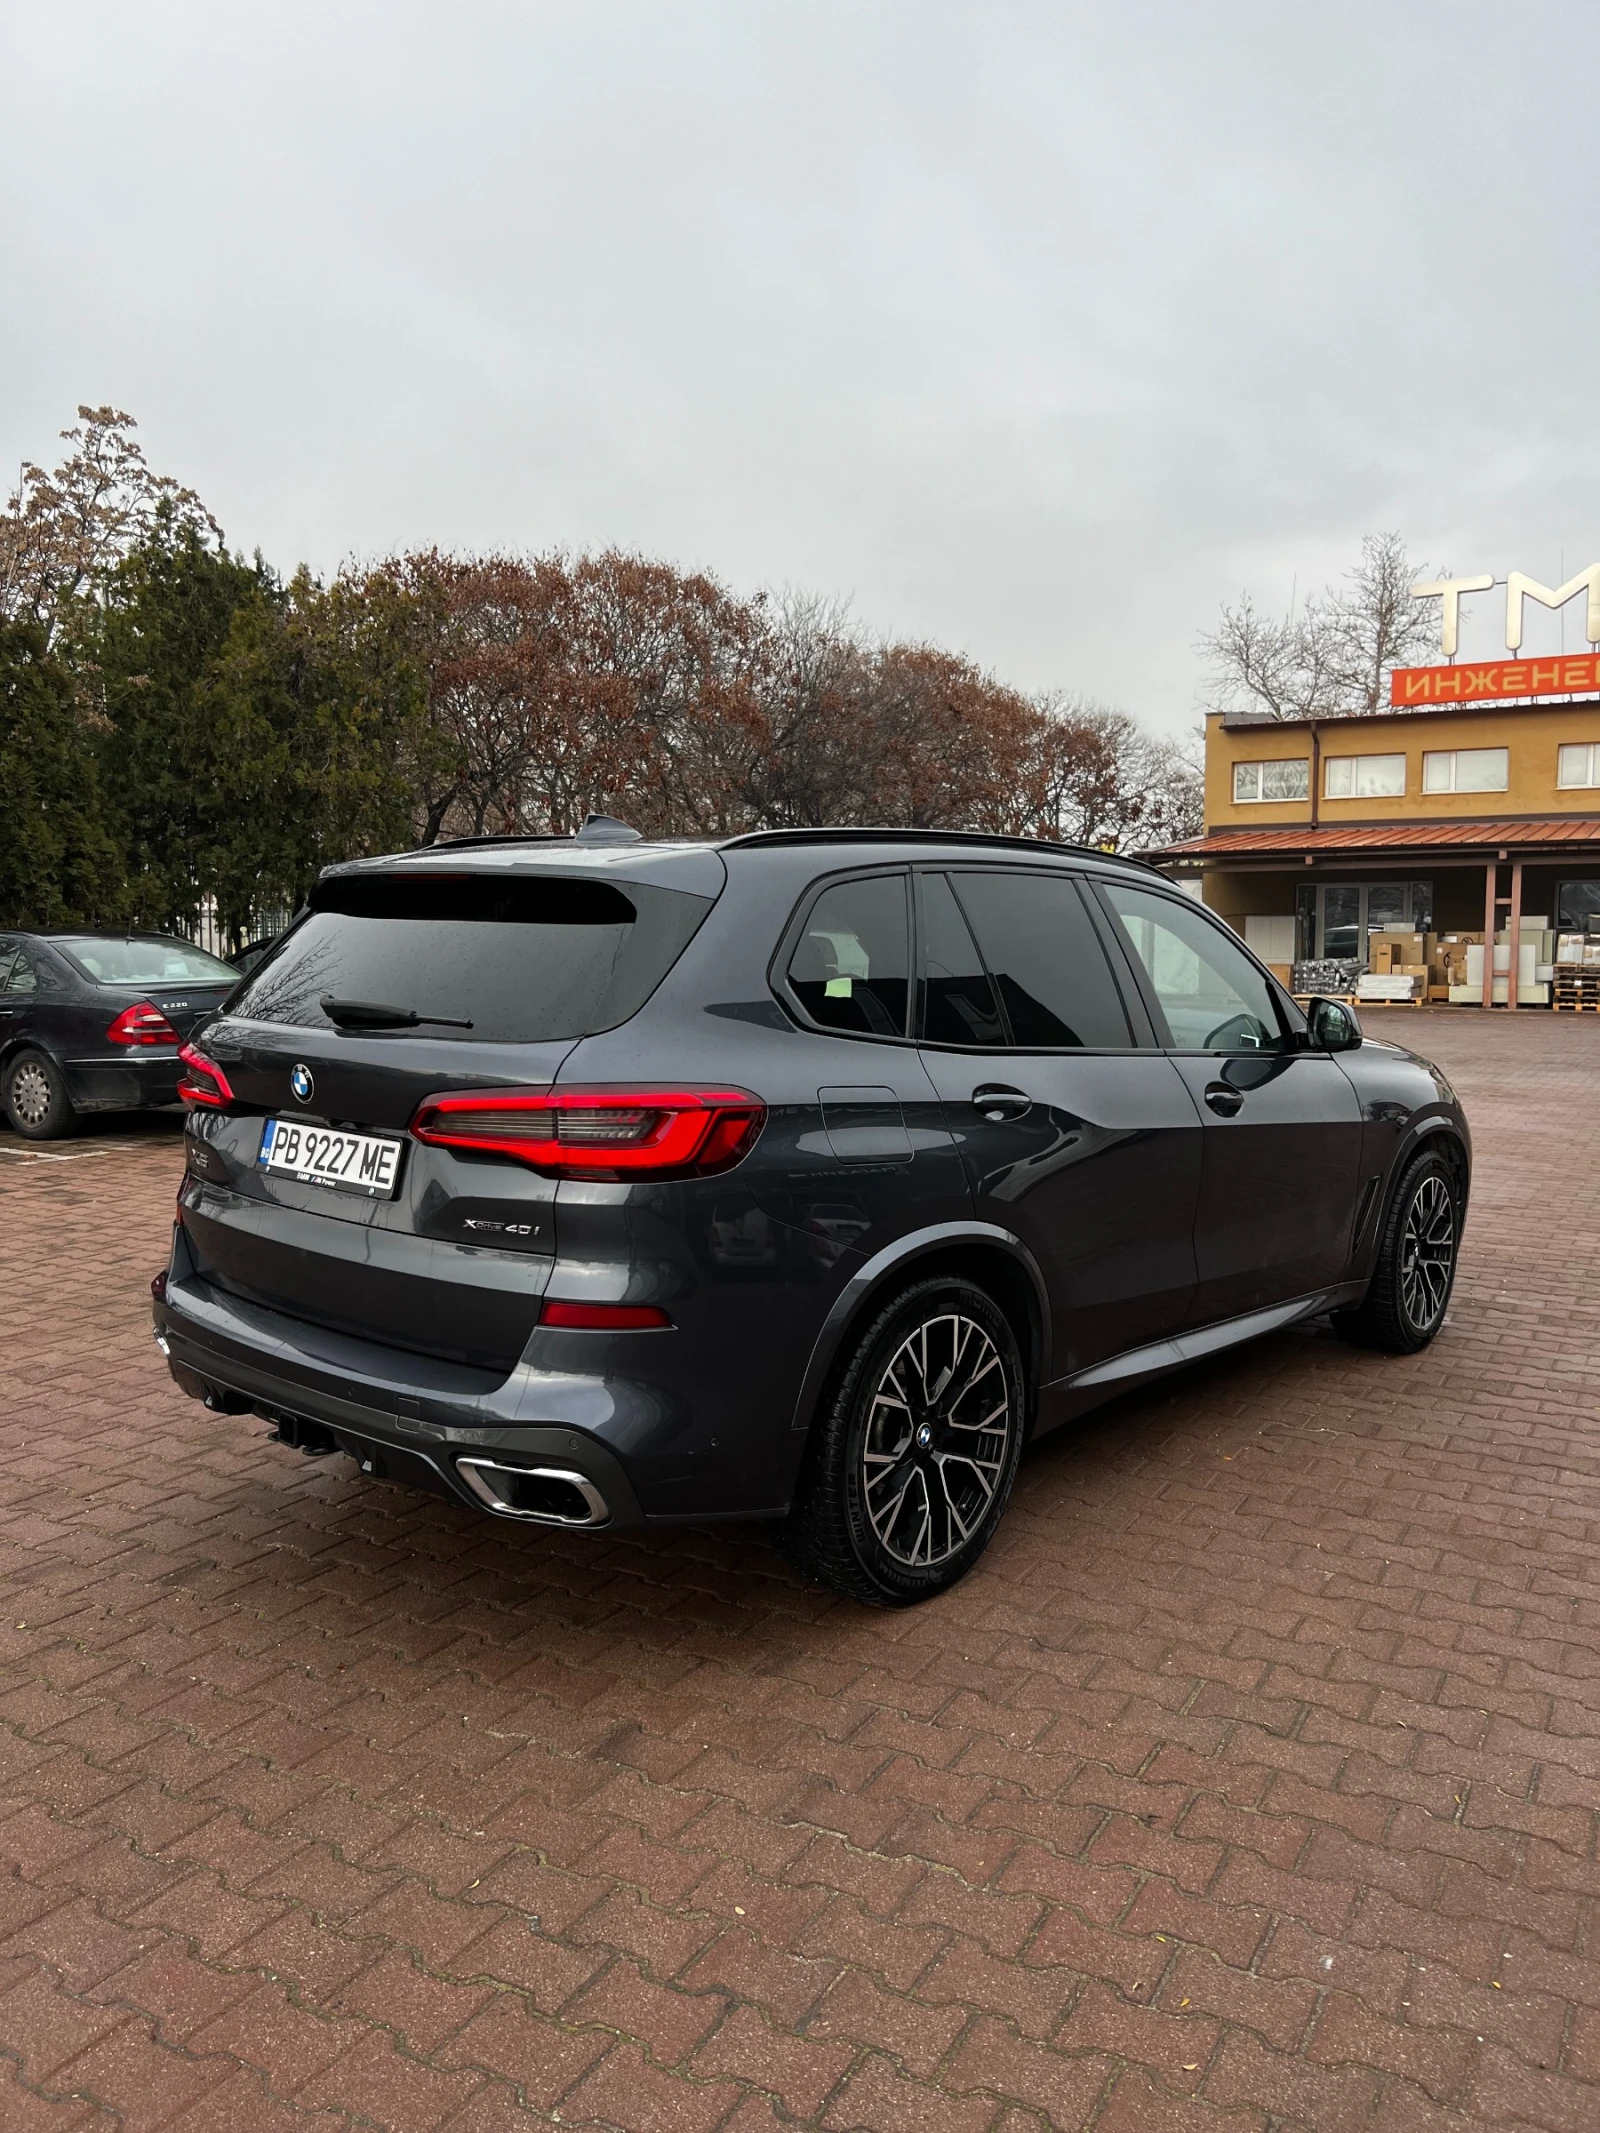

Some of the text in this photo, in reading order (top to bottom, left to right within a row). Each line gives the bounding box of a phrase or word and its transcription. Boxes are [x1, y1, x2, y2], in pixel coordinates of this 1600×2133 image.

[260, 1146, 271, 1159] BG
[271, 1126, 396, 1185] PB 9227 ME
[847, 1472, 866, 1543] WINTER
